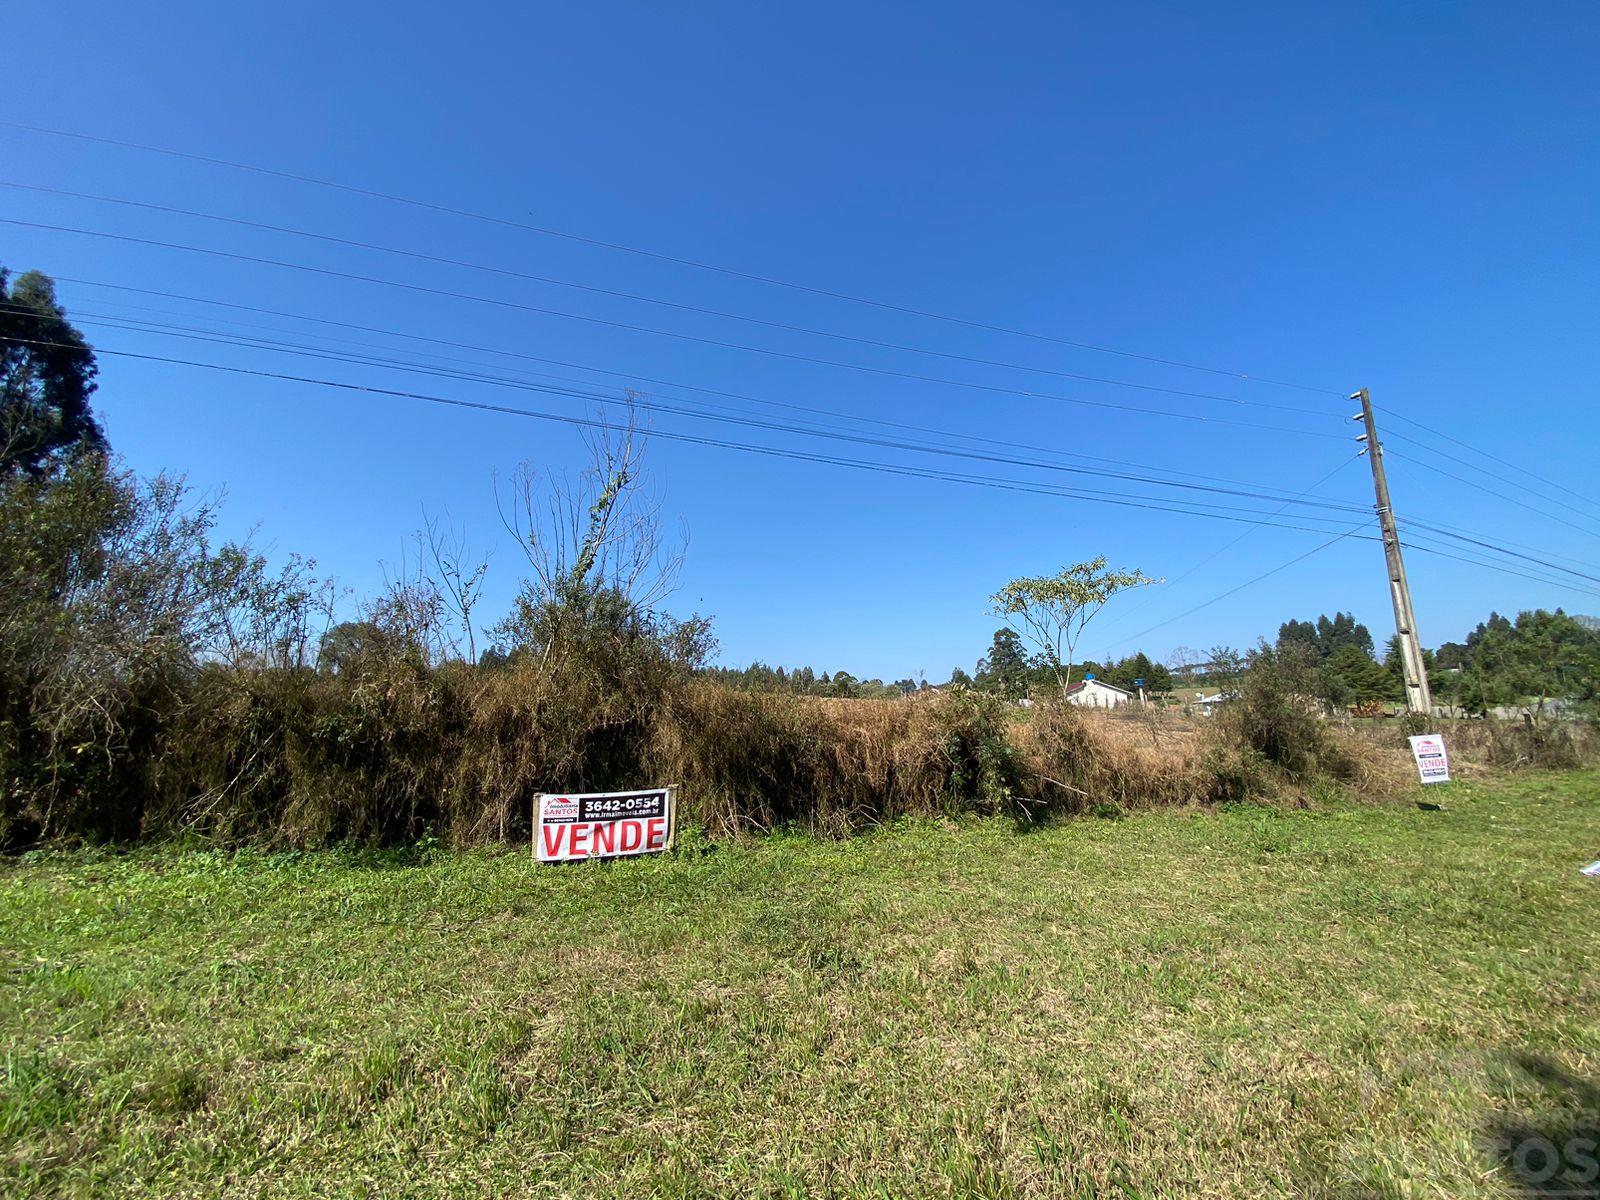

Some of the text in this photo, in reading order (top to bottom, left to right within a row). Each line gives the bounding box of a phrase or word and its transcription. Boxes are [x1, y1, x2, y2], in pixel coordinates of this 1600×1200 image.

[1418, 758, 1446, 768] VENDE
[585, 796, 660, 812] 3642-0554
[543, 819, 665, 857] VENDE
